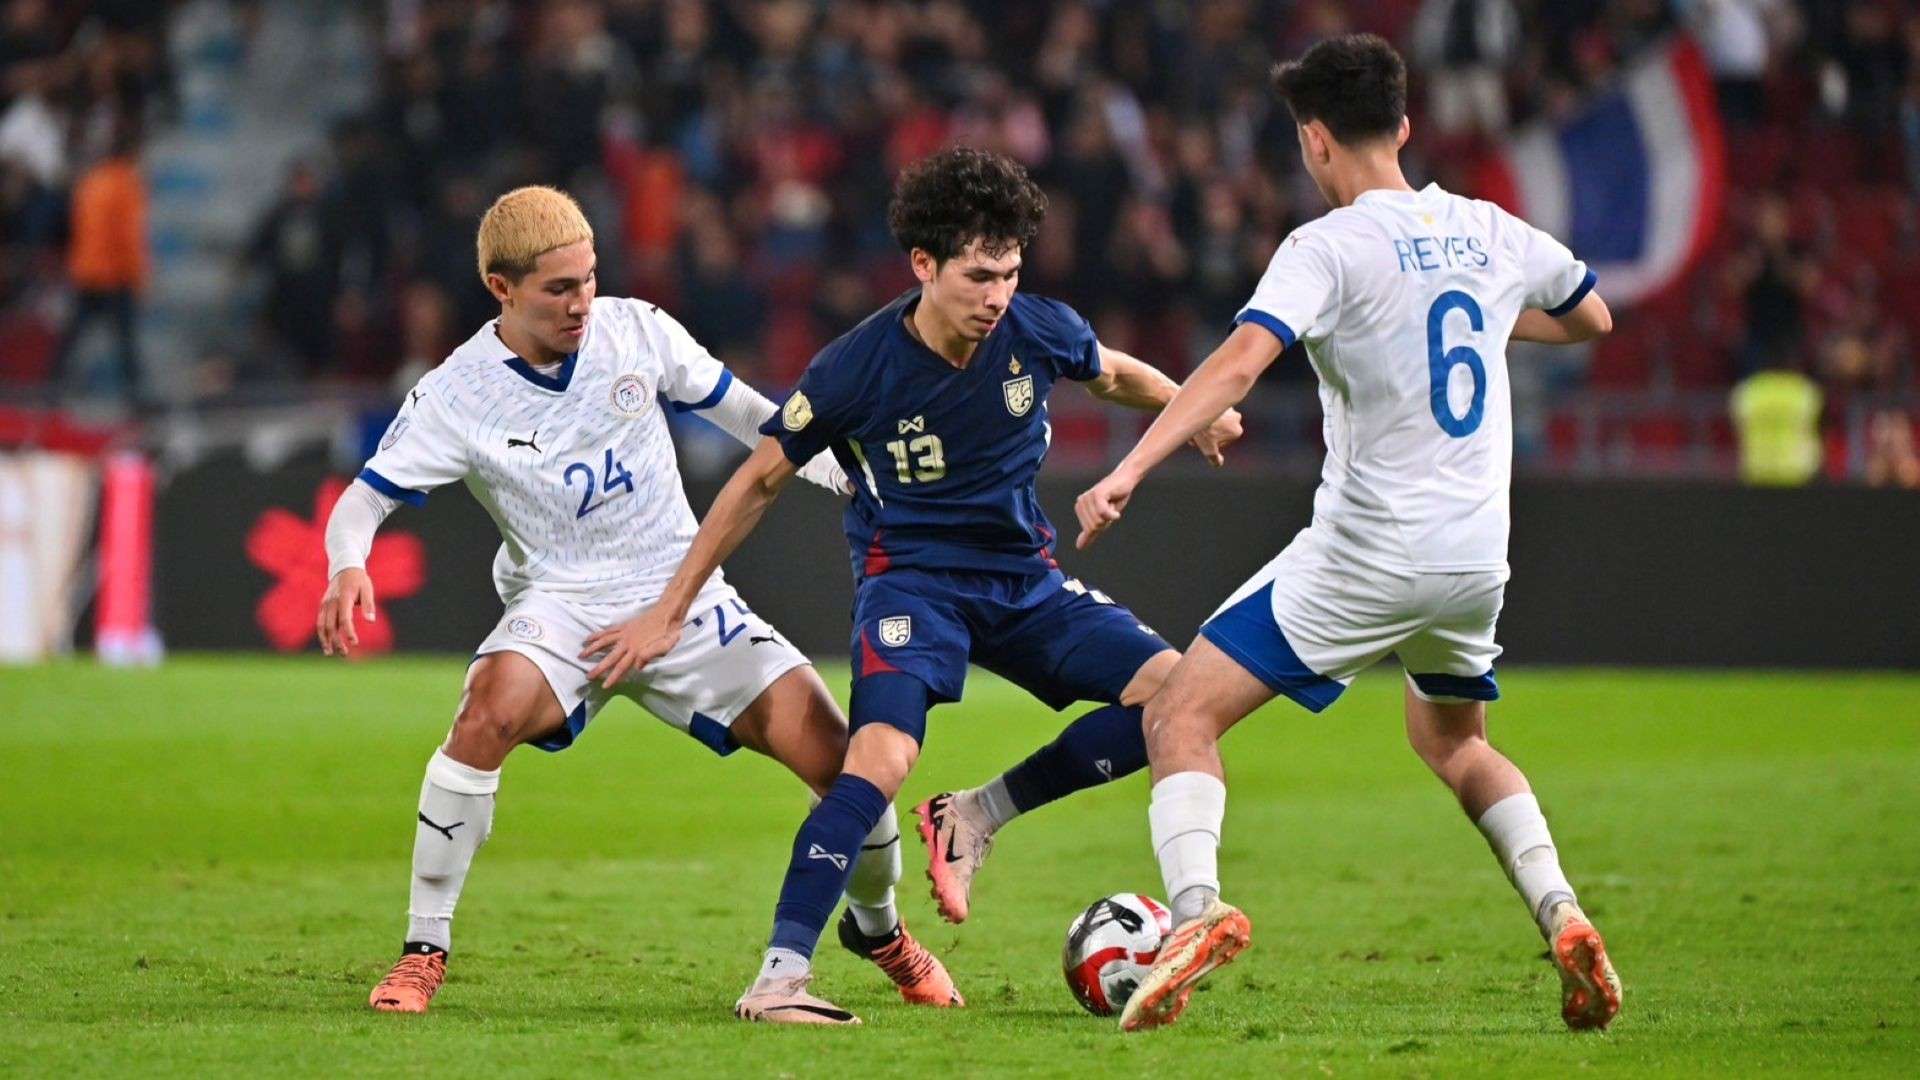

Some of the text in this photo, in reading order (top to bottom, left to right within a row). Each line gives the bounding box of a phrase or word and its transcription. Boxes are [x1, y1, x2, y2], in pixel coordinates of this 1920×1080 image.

[1392, 236, 1489, 273] REYES
[1426, 289, 1487, 439] 6
[563, 447, 634, 520] 24
[886, 433, 947, 484] 13
